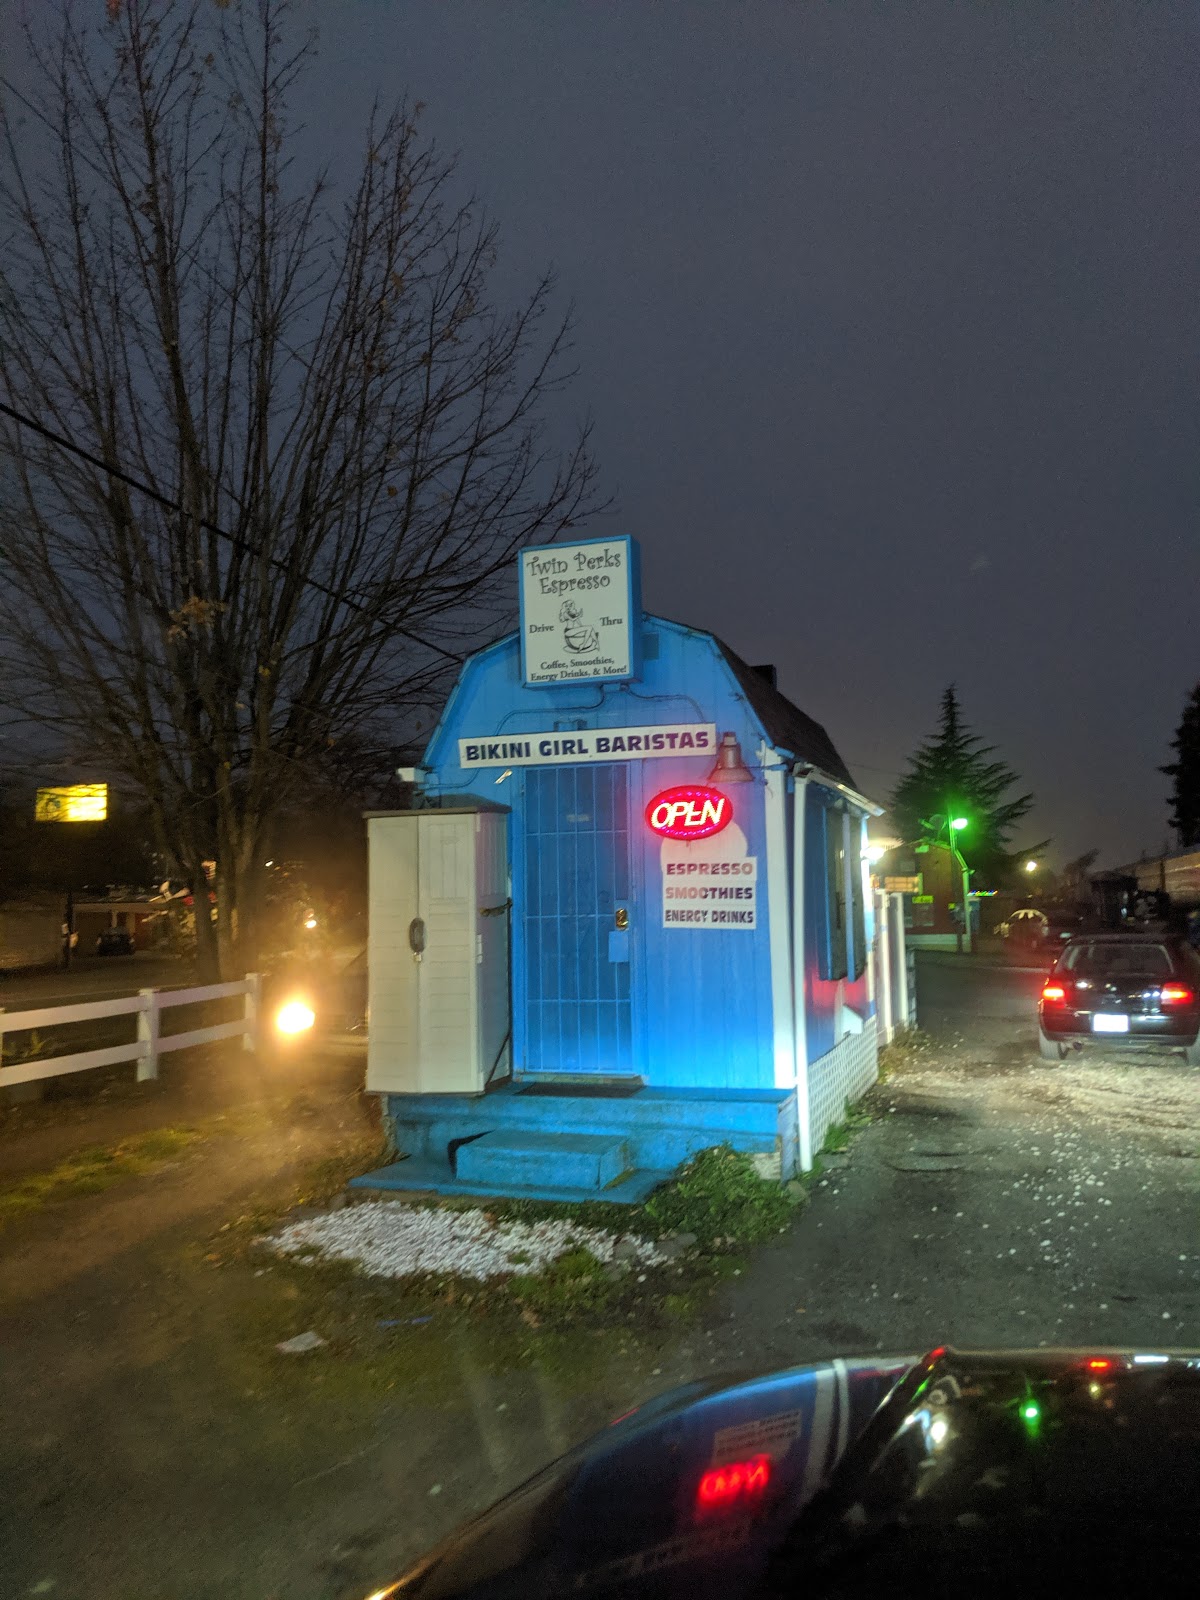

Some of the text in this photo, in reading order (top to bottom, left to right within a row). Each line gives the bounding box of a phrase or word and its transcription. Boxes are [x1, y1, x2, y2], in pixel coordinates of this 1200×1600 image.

[526, 549, 621, 576] Twin Perks
[540, 575, 610, 596] Espresso
[529, 616, 623, 634] Drive Thru
[540, 657, 614, 670] Coffee, Smoothies,
[531, 672, 559, 681] Energy
[560, 669, 591, 679] Drinks,
[603, 665, 627, 674] More!
[466, 732, 709, 761] BIKINI GIRL BARISTAS
[651, 798, 725, 828] OPEN
[666, 863, 753, 875] ESPRESSO
[665, 886, 753, 900] SMOOTHIES
[665, 909, 754, 923] ENERGY DRINKS
